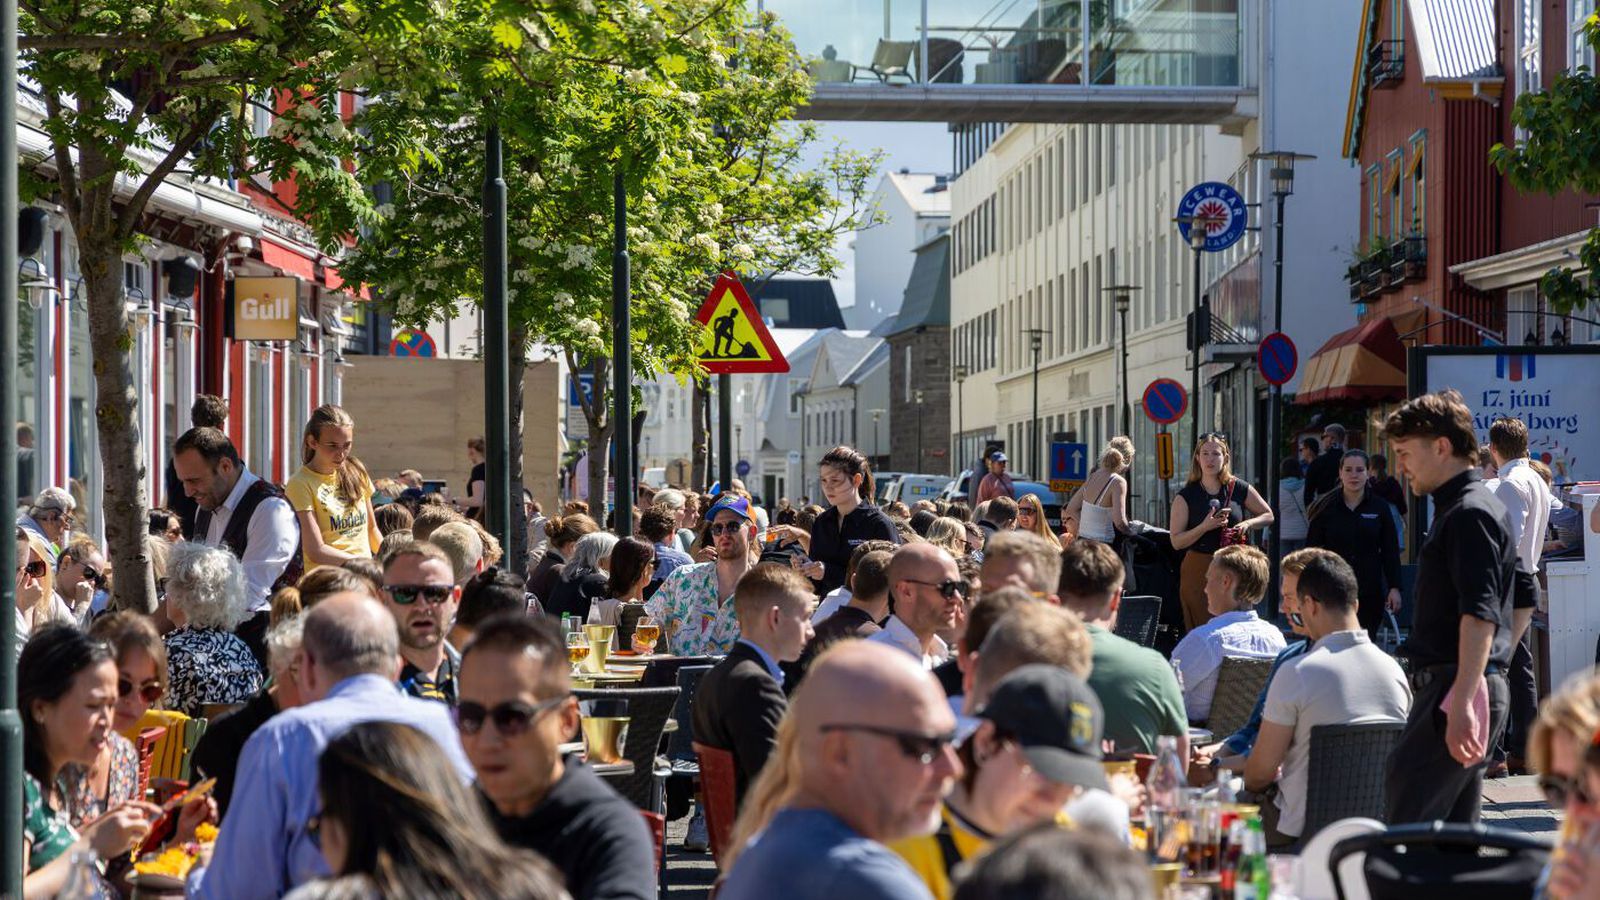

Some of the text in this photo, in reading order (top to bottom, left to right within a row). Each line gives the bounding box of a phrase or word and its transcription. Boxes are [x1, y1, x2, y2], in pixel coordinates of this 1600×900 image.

[1183, 186, 1242, 216] ICEWEAR
[240, 297, 289, 319] Gull
[1482, 389, 1551, 409] 17. júní
[1528, 412, 1578, 433] borg
